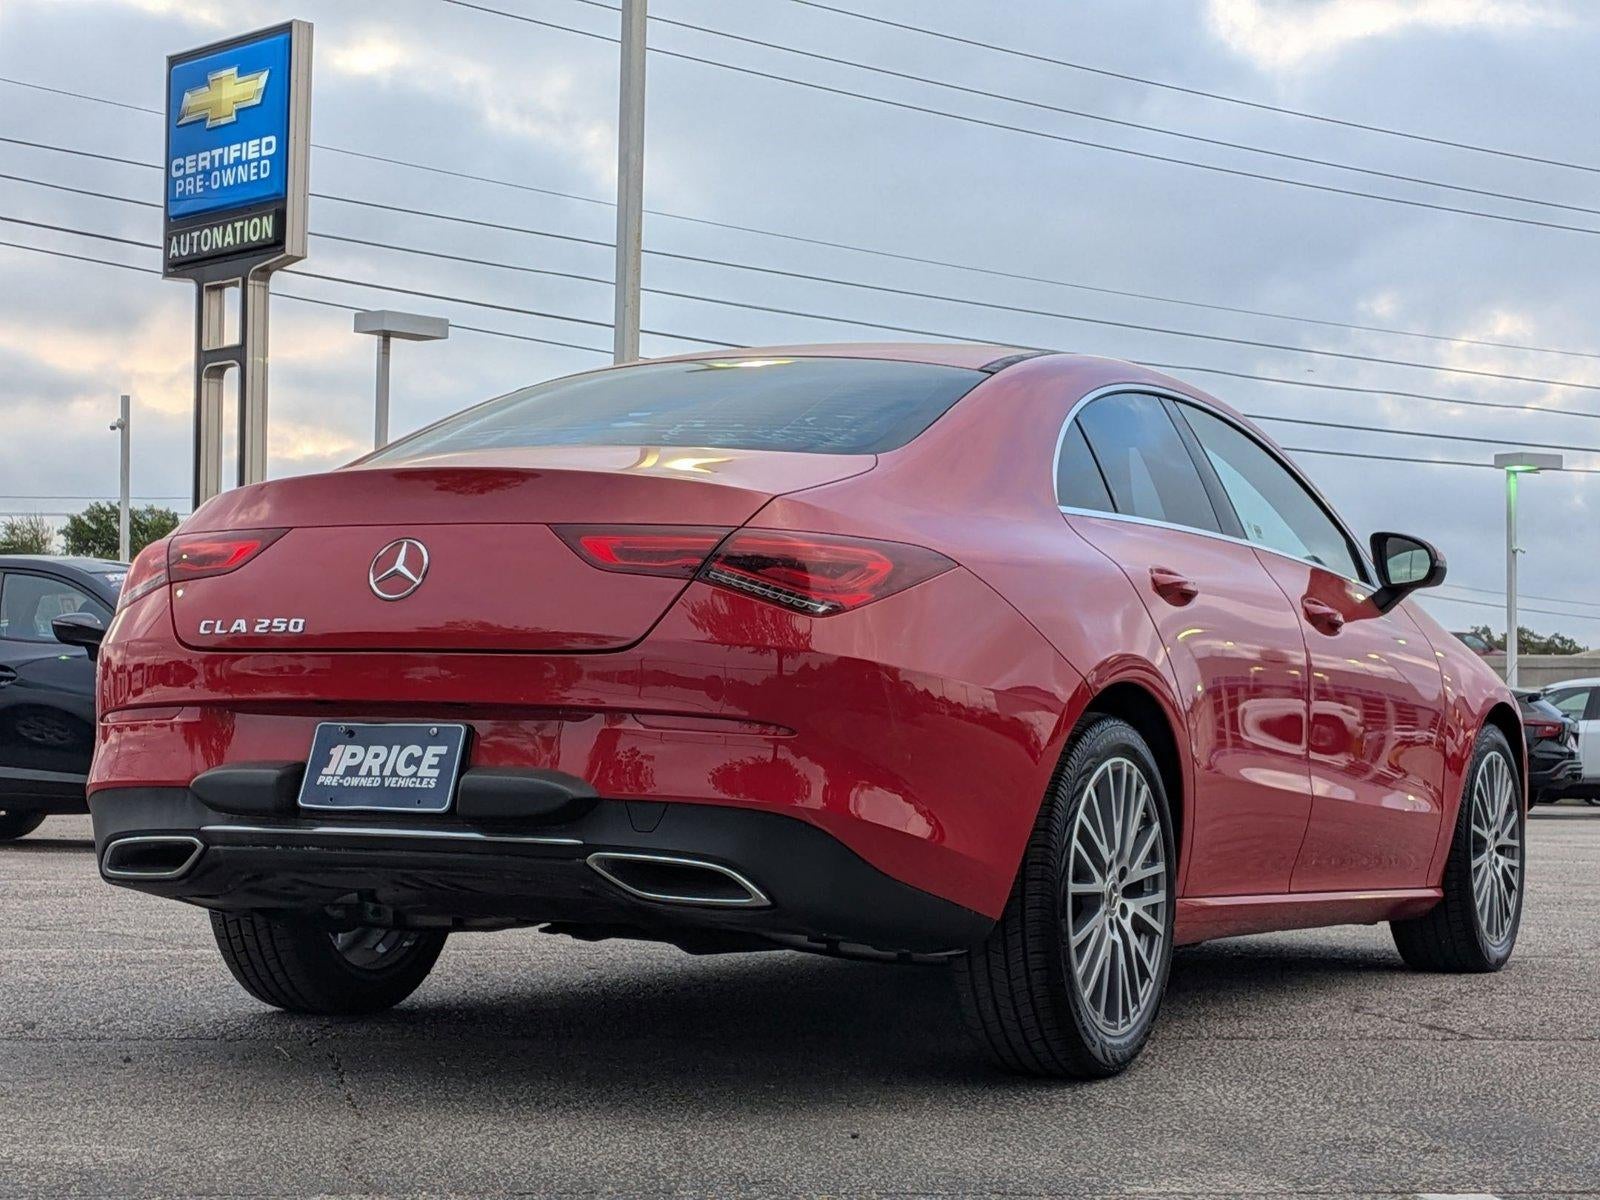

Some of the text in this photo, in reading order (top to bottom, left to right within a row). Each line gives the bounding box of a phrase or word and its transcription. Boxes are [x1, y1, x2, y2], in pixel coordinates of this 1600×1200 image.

[171, 135, 277, 178] CERTIFIED
[175, 159, 271, 198] PRE-OWNED
[169, 214, 273, 259] AUTONATION
[199, 617, 305, 634] CLA 250
[321, 744, 448, 777] 1PRICE
[316, 775, 437, 789] PRE-OWNED VEHICLES
